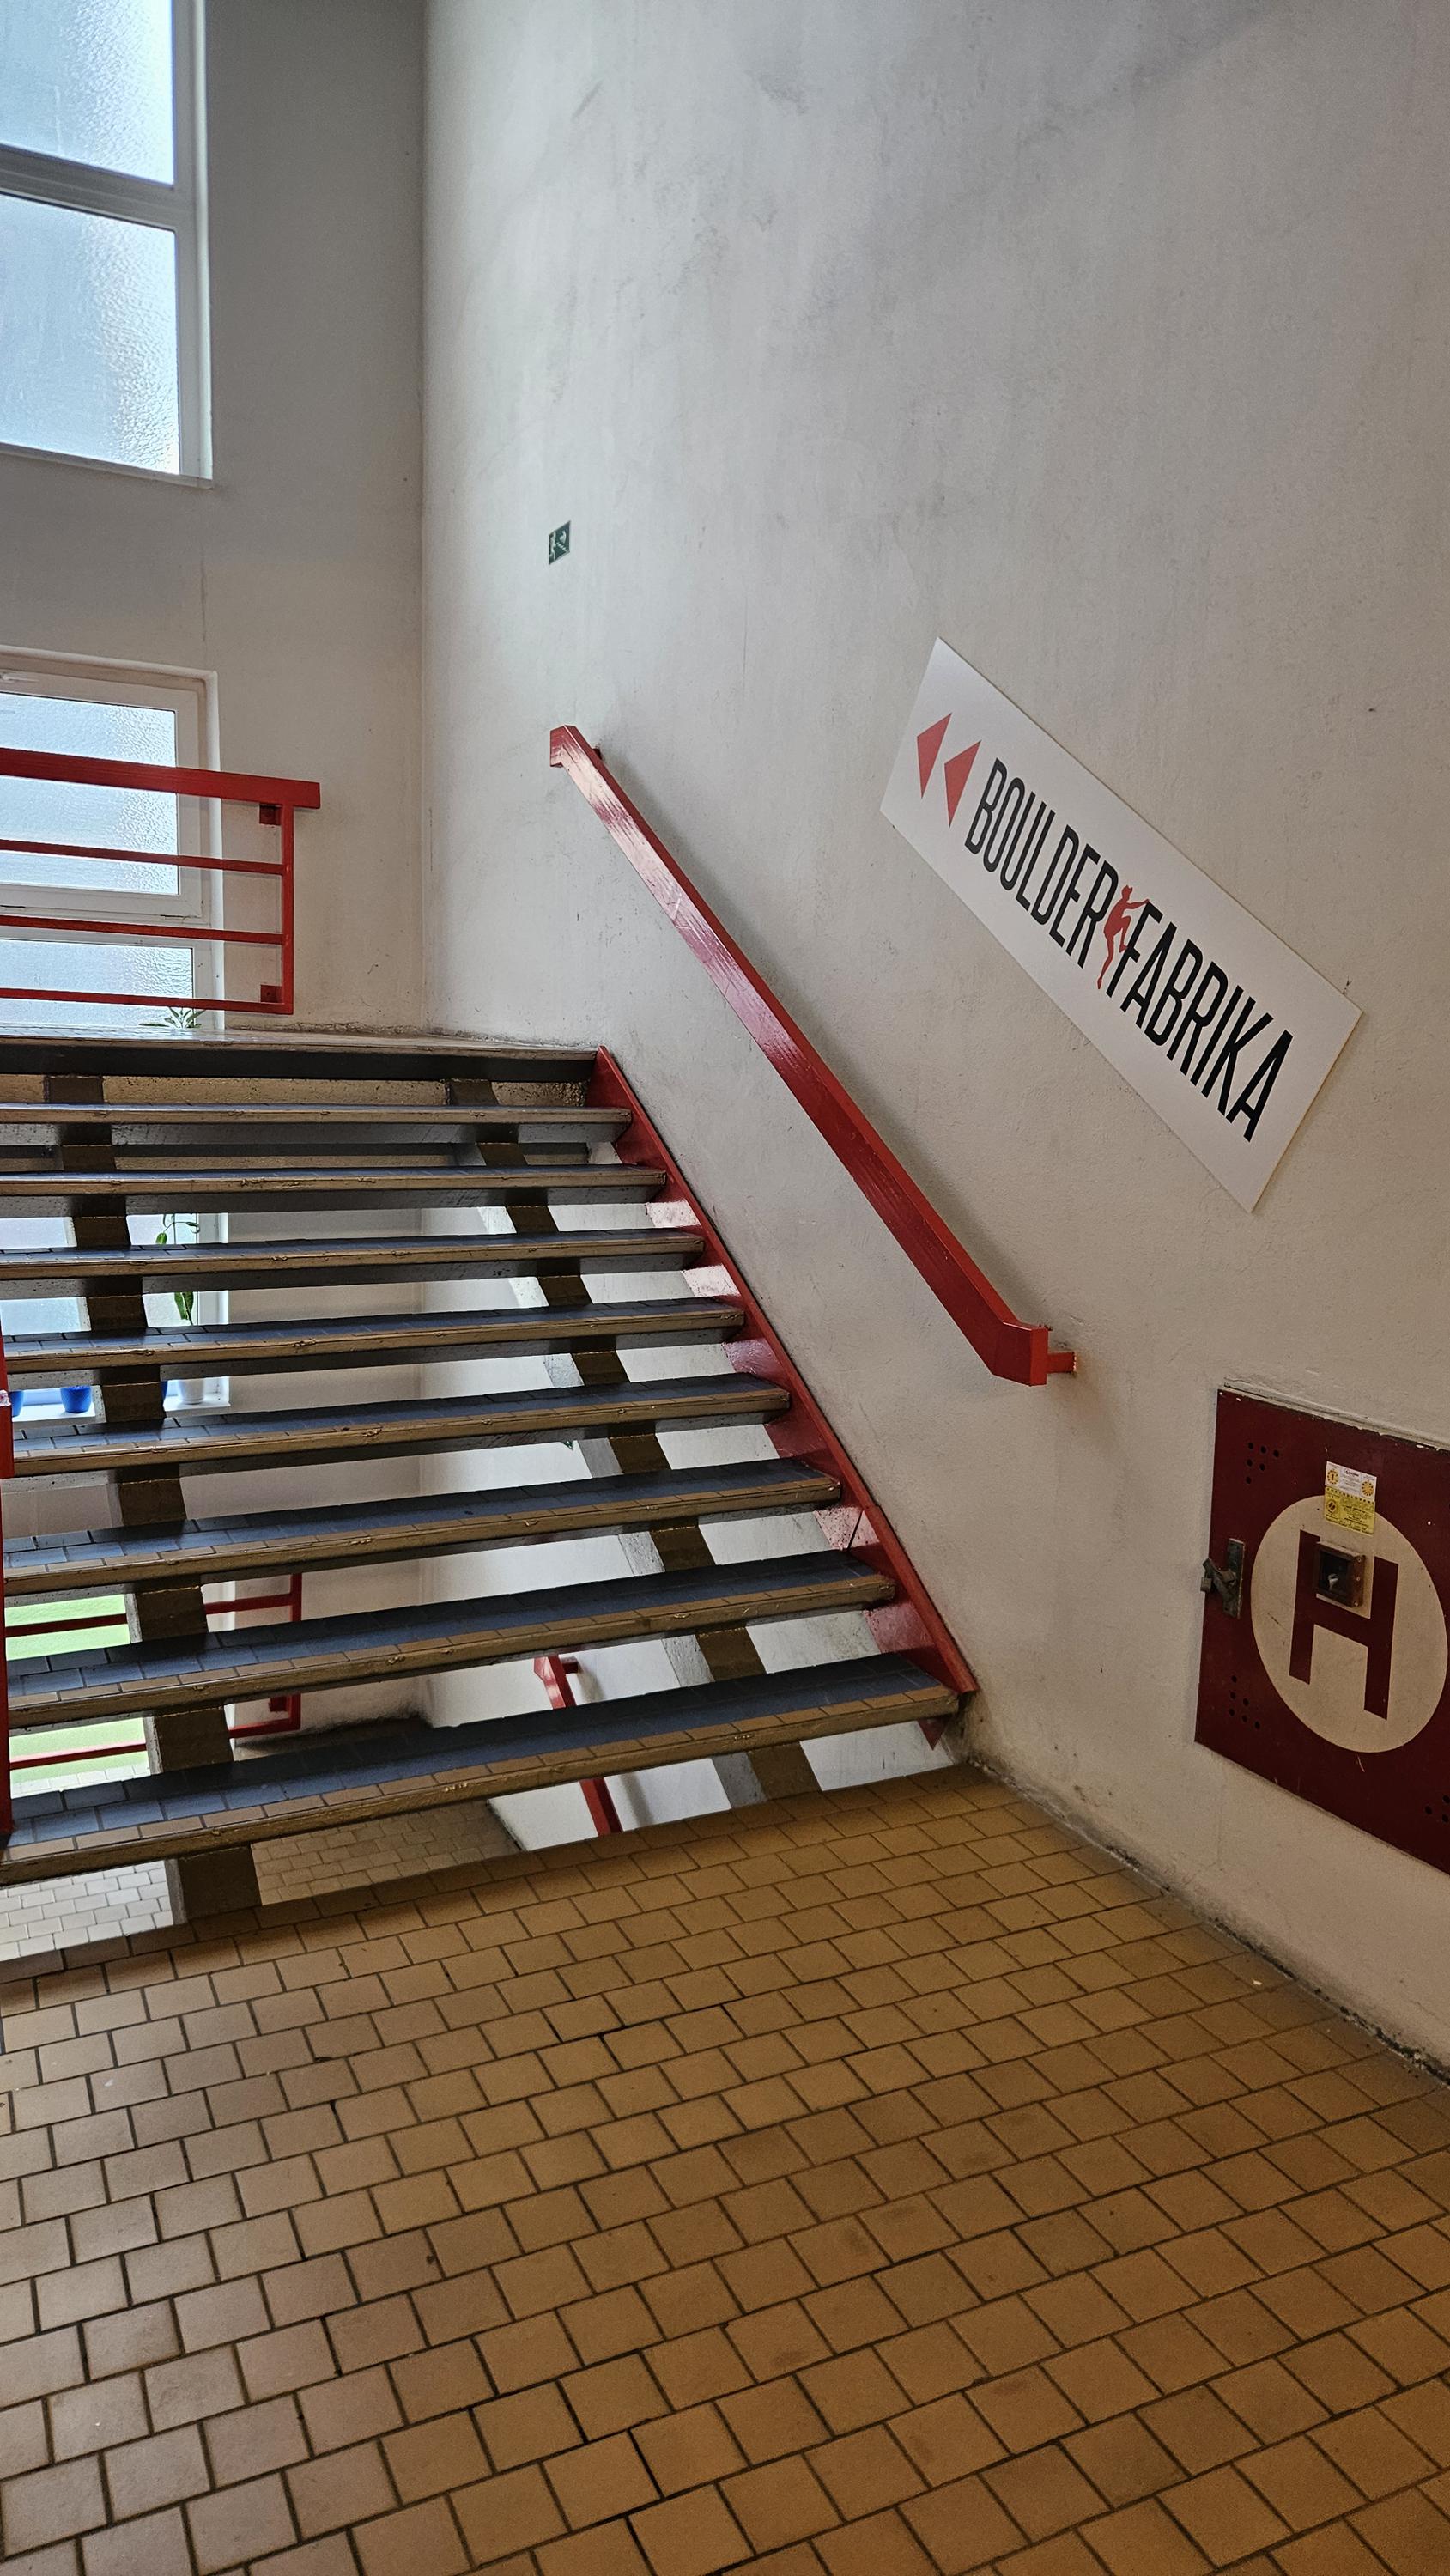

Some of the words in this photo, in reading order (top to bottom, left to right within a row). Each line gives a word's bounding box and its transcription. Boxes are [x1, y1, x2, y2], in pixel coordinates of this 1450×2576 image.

[964, 757, 1119, 969] BOULDER
[1105, 899, 1294, 1143] FABRIKA
[1289, 1529, 1399, 1721] H
